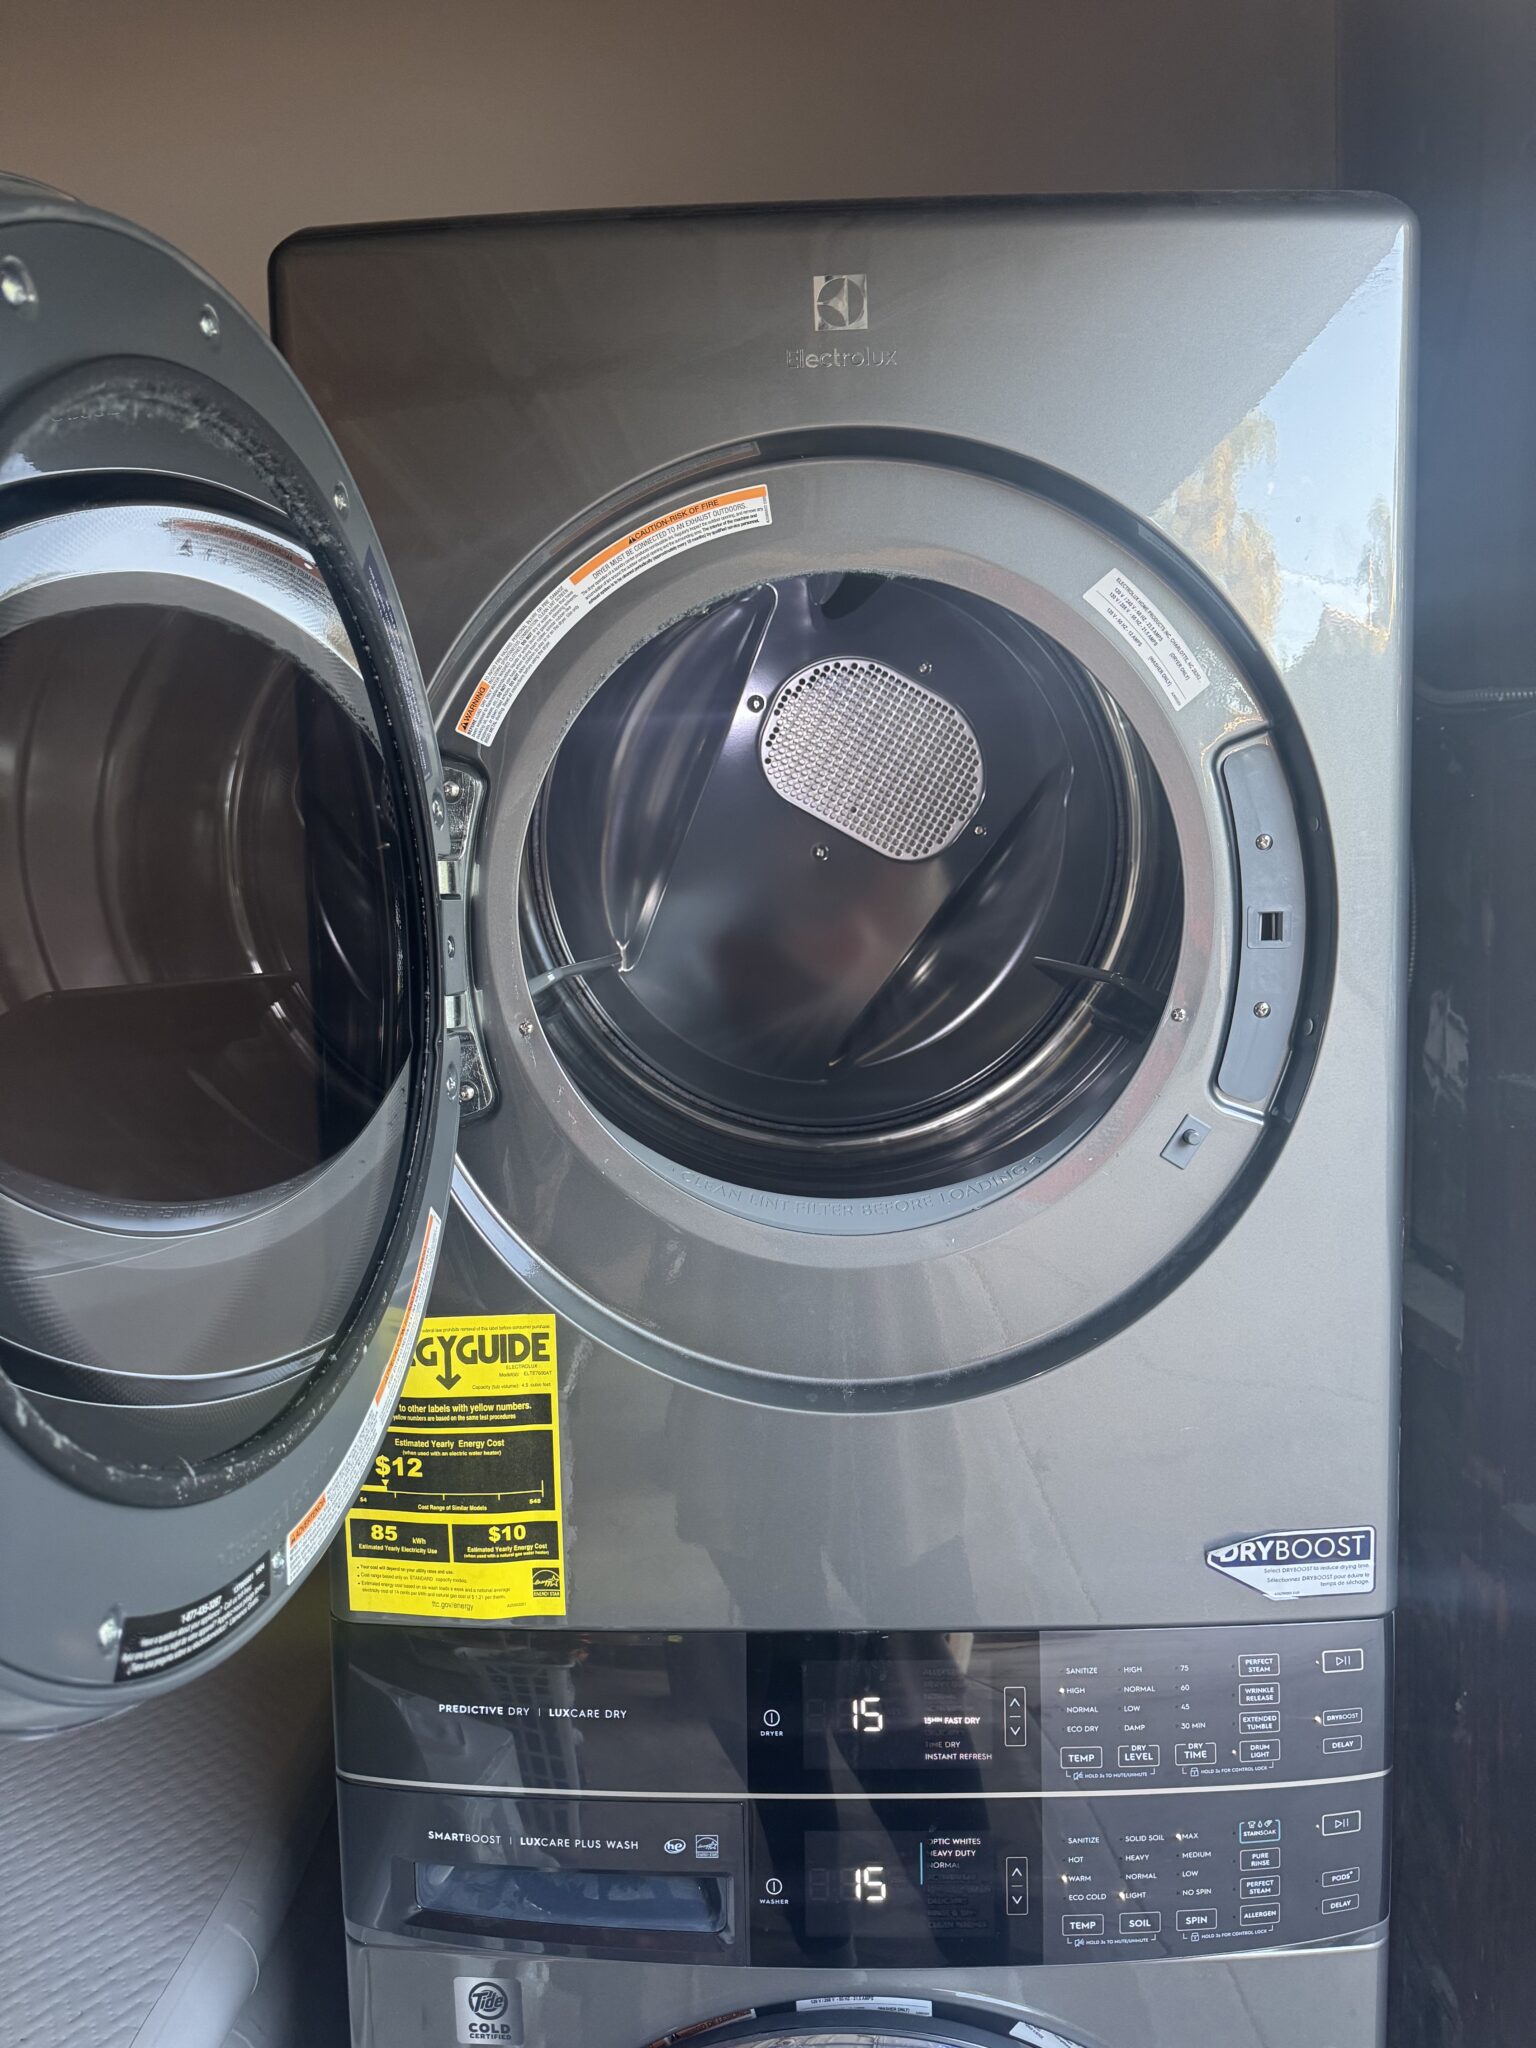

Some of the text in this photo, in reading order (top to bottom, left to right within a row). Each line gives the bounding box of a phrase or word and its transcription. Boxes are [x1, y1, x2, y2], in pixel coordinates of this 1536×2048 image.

[787, 348, 897, 369] Electrolux
[689, 505, 699, 516] OF
[701, 499, 719, 511] FIRE
[592, 562, 609, 579] DRYER
[611, 553, 625, 568] MUST
[626, 547, 634, 558] BE
[634, 531, 667, 554] CONNECTED
[667, 527, 675, 536] TO
[676, 522, 685, 531] AN
[685, 513, 712, 529] EXHAUST
[1115, 577, 1139, 602] ELECTROLUX
[1138, 599, 1150, 613] HOME
[1148, 610, 1166, 633] PRODUCTS
[464, 687, 485, 721] WARNING
[680, 1163, 1028, 1217] CLEAN LINT FILTER BEFORE LOADING
[411, 1333, 550, 1366] GYGUIDE
[407, 1404, 426, 1412] other
[428, 1403, 450, 1412] labels
[452, 1402, 469, 1411] with
[470, 1402, 494, 1414] yellow
[496, 1401, 532, 1411] numbers.
[395, 1438, 505, 1449] Estimated Yearly Energy Cost
[375, 1454, 423, 1478] $12
[371, 1525, 398, 1541] 85
[488, 1525, 526, 1543] $10
[412, 1537, 426, 1545] kWh
[358, 1543, 384, 1551] Estimated
[384, 1544, 400, 1553] Yearly
[401, 1546, 427, 1554] Electricity
[495, 1545, 513, 1553] Yearly
[513, 1543, 533, 1552] Energy
[1219, 1534, 1366, 1563] DRYBOOST
[1245, 1658, 1273, 1666] PERFECT
[1246, 1694, 1274, 1702] RELEASE
[438, 1703, 530, 1716] PREDICTIVE DRY
[548, 1708, 627, 1719] LUXCARE DRY
[852, 1696, 883, 1732] 15
[944, 1716, 963, 1725] FAST
[964, 1716, 981, 1725] DRY
[1326, 1713, 1359, 1721] DRYBOOST
[1331, 1741, 1354, 1749] DELAY
[1068, 1754, 1095, 1763] TEMP
[1124, 1752, 1154, 1761] LEVEL
[1184, 1750, 1207, 1759] TIME
[428, 1830, 502, 1845] SMARTBOOST
[520, 1836, 639, 1850] LUXCARE PLUS WASH
[952, 1837, 981, 1845] WHITES
[1068, 1836, 1100, 1844] SANITIZE
[955, 1849, 976, 1857] DUTY
[1331, 1871, 1354, 1882] PODS
[855, 1866, 887, 1901] 15
[1246, 1879, 1274, 1887] PERFECT
[1249, 1887, 1271, 1895] STEAM
[1330, 1900, 1351, 1909] DELAY
[1244, 1910, 1276, 1918] ALLERGEN
[1070, 1921, 1096, 1930] TEMP
[1129, 1919, 1151, 1928] SOIL
[1185, 1916, 1208, 1925] SPIN
[472, 1990, 504, 2013] Tide
[469, 2022, 511, 2034] COLD
